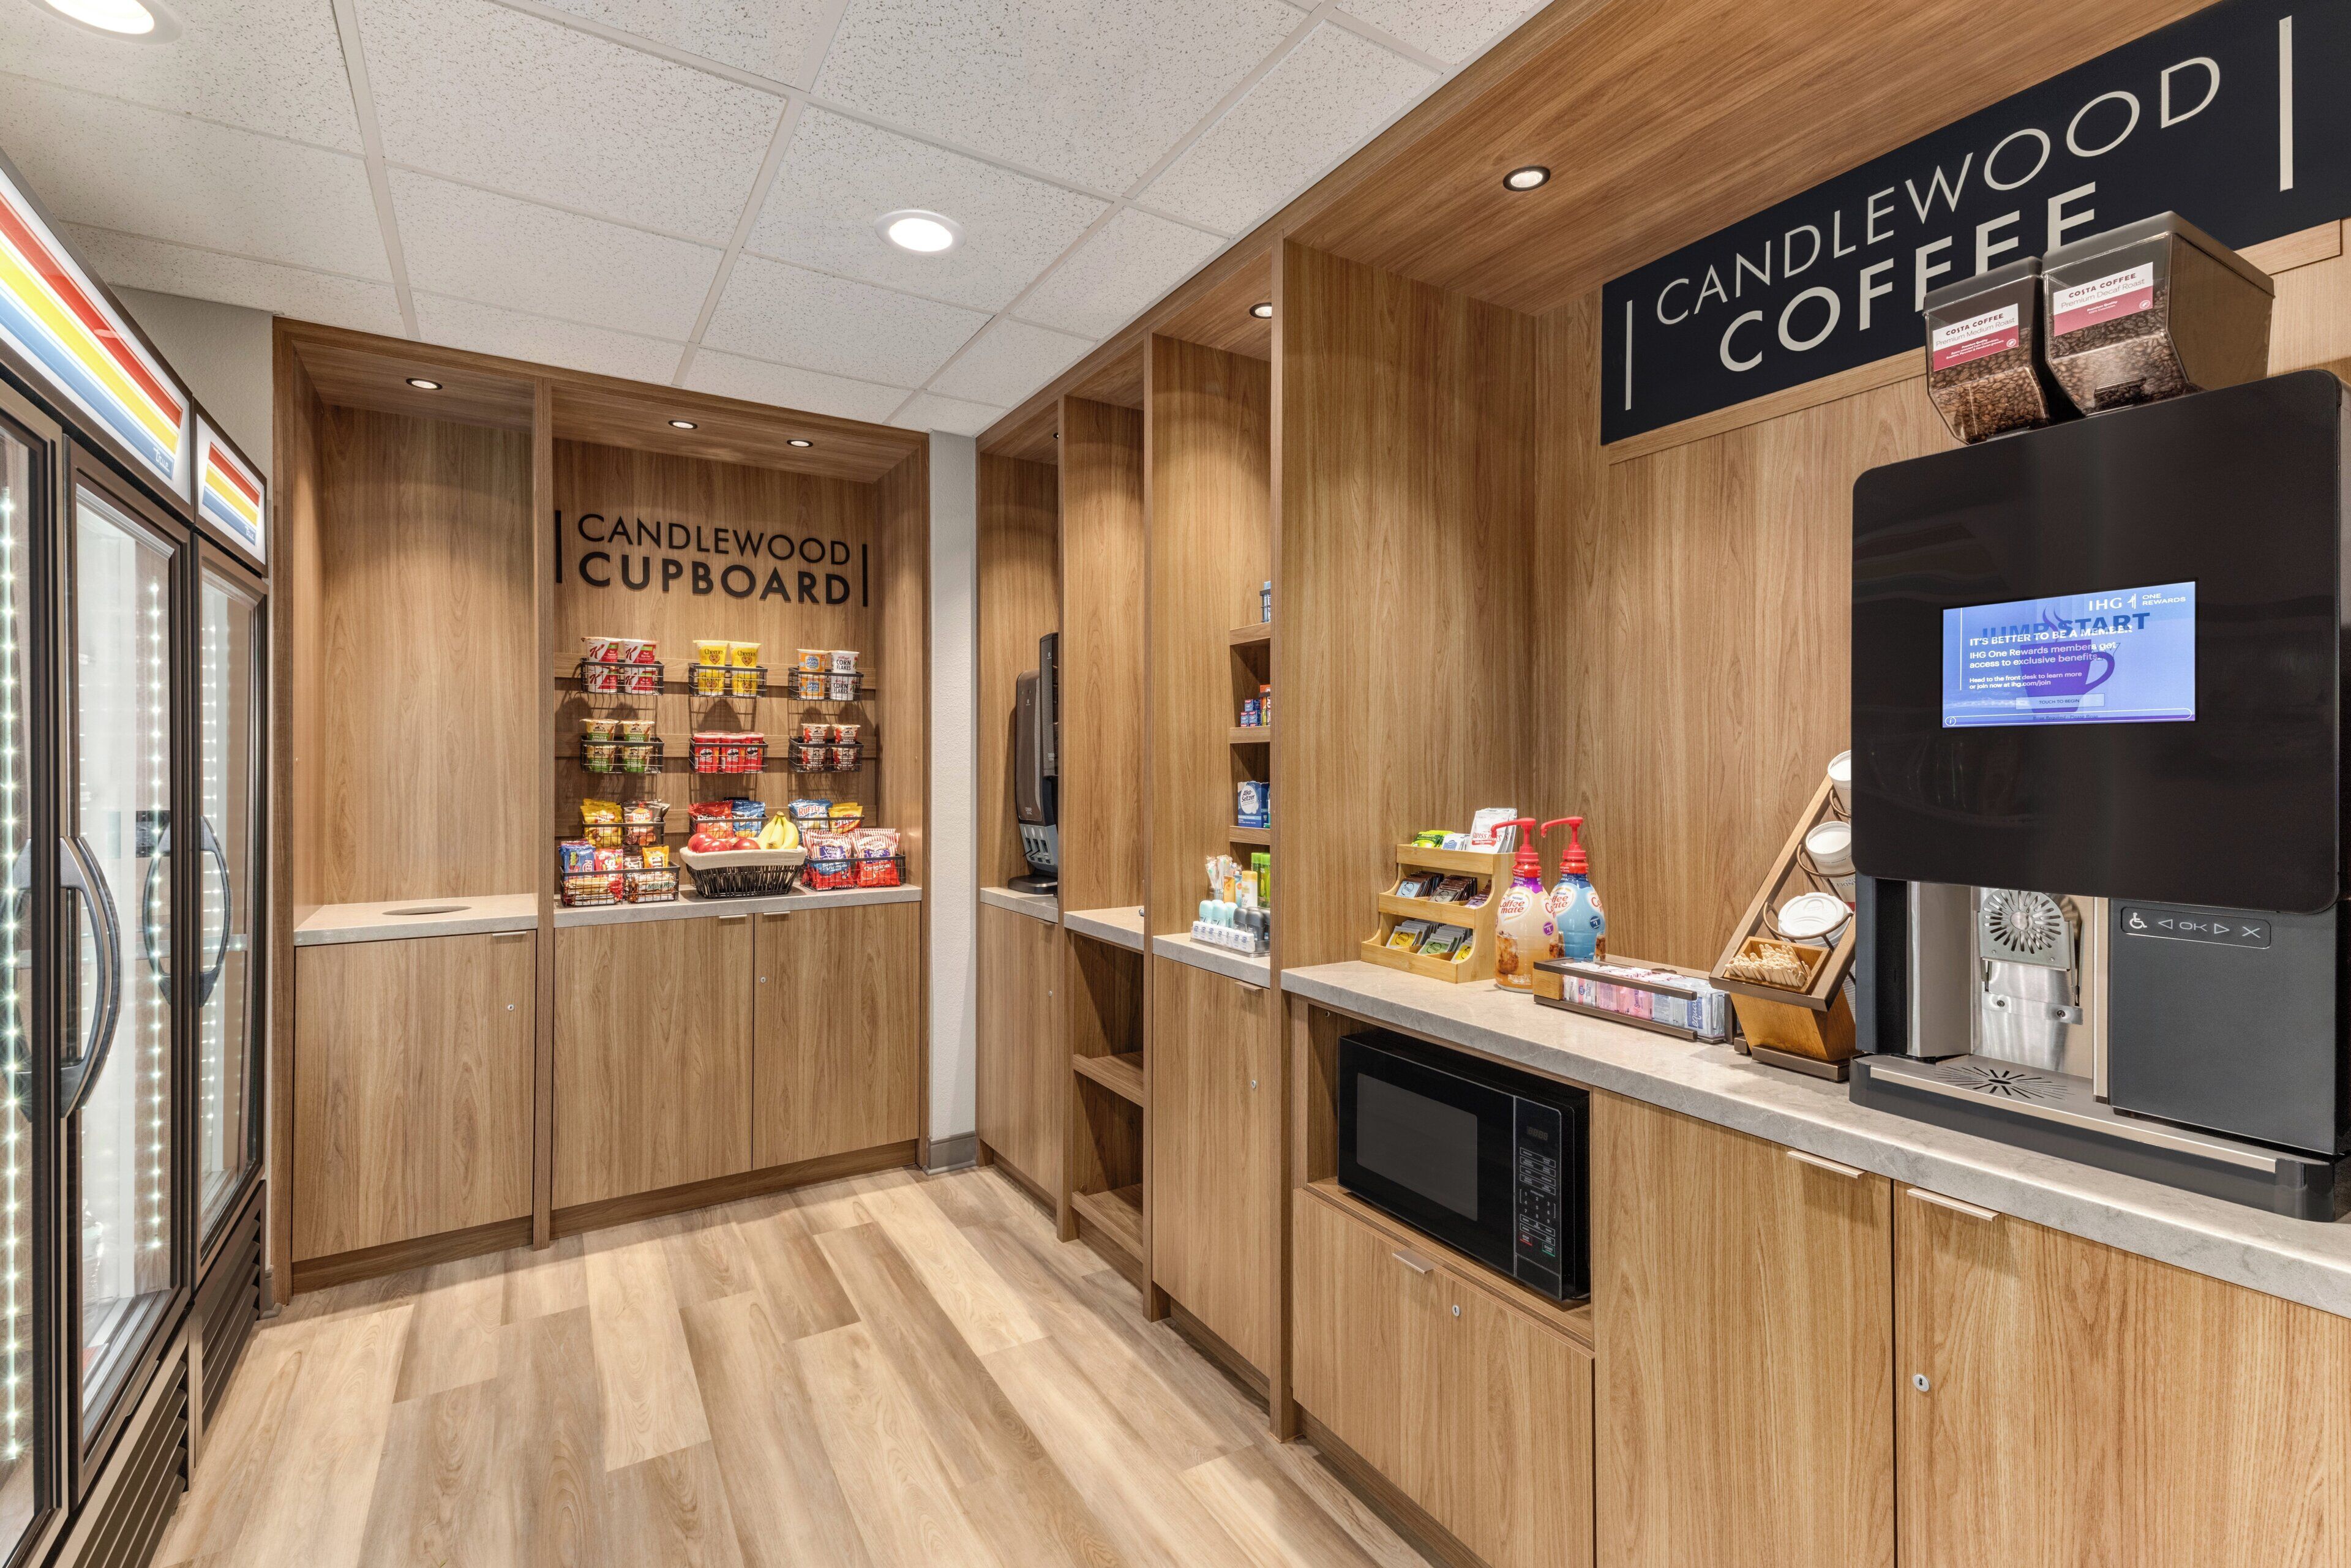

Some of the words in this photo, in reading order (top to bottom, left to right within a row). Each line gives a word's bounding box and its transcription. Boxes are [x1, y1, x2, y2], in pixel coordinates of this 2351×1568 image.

[1657, 56, 2220, 325] CANDLEWOOD
[1719, 181, 2096, 373] COFFEE
[2069, 286, 2096, 298] COSTA
[2100, 273, 2136, 288] COFFEE
[2061, 295, 2095, 309] Premium
[2097, 285, 2120, 298] Decaf
[2122, 279, 2145, 290] Roast
[1936, 333, 1965, 347] Premium
[1967, 325, 1994, 337] Medium
[1995, 317, 2015, 328] Roast
[1946, 324, 1970, 336] COSTA
[1972, 313, 2004, 327] COFFEE
[577, 513, 850, 565] CANDLEWOOD
[579, 552, 850, 604] CUPBOARD
[2088, 598, 2122, 611] IHG
[2142, 596, 2186, 606] REWARDS
[1970, 637, 1989, 647] IT'S
[1991, 634, 2031, 644] BETTER
[2033, 632, 2049, 640] TO
[2052, 631, 2068, 639] BE
[2069, 629, 2079, 637] A
[2080, 625, 2133, 637] MEMBER
[590, 644, 605, 659] K
[625, 646, 638, 661] K
[2009, 646, 2049, 657] Rewards
[2051, 643, 2097, 653] members
[2099, 642, 2117, 651] get
[1970, 659, 2000, 669] access
[2013, 656, 2056, 666] exclusive
[2011, 679, 2051, 688] ihg.com/join
[632, 811, 650, 820] Lay's
[797, 805, 825, 817] RUFFLES
[864, 863, 891, 871] Original
[1500, 898, 1524, 907] Coffee
[2179, 921, 2208, 932] OK
